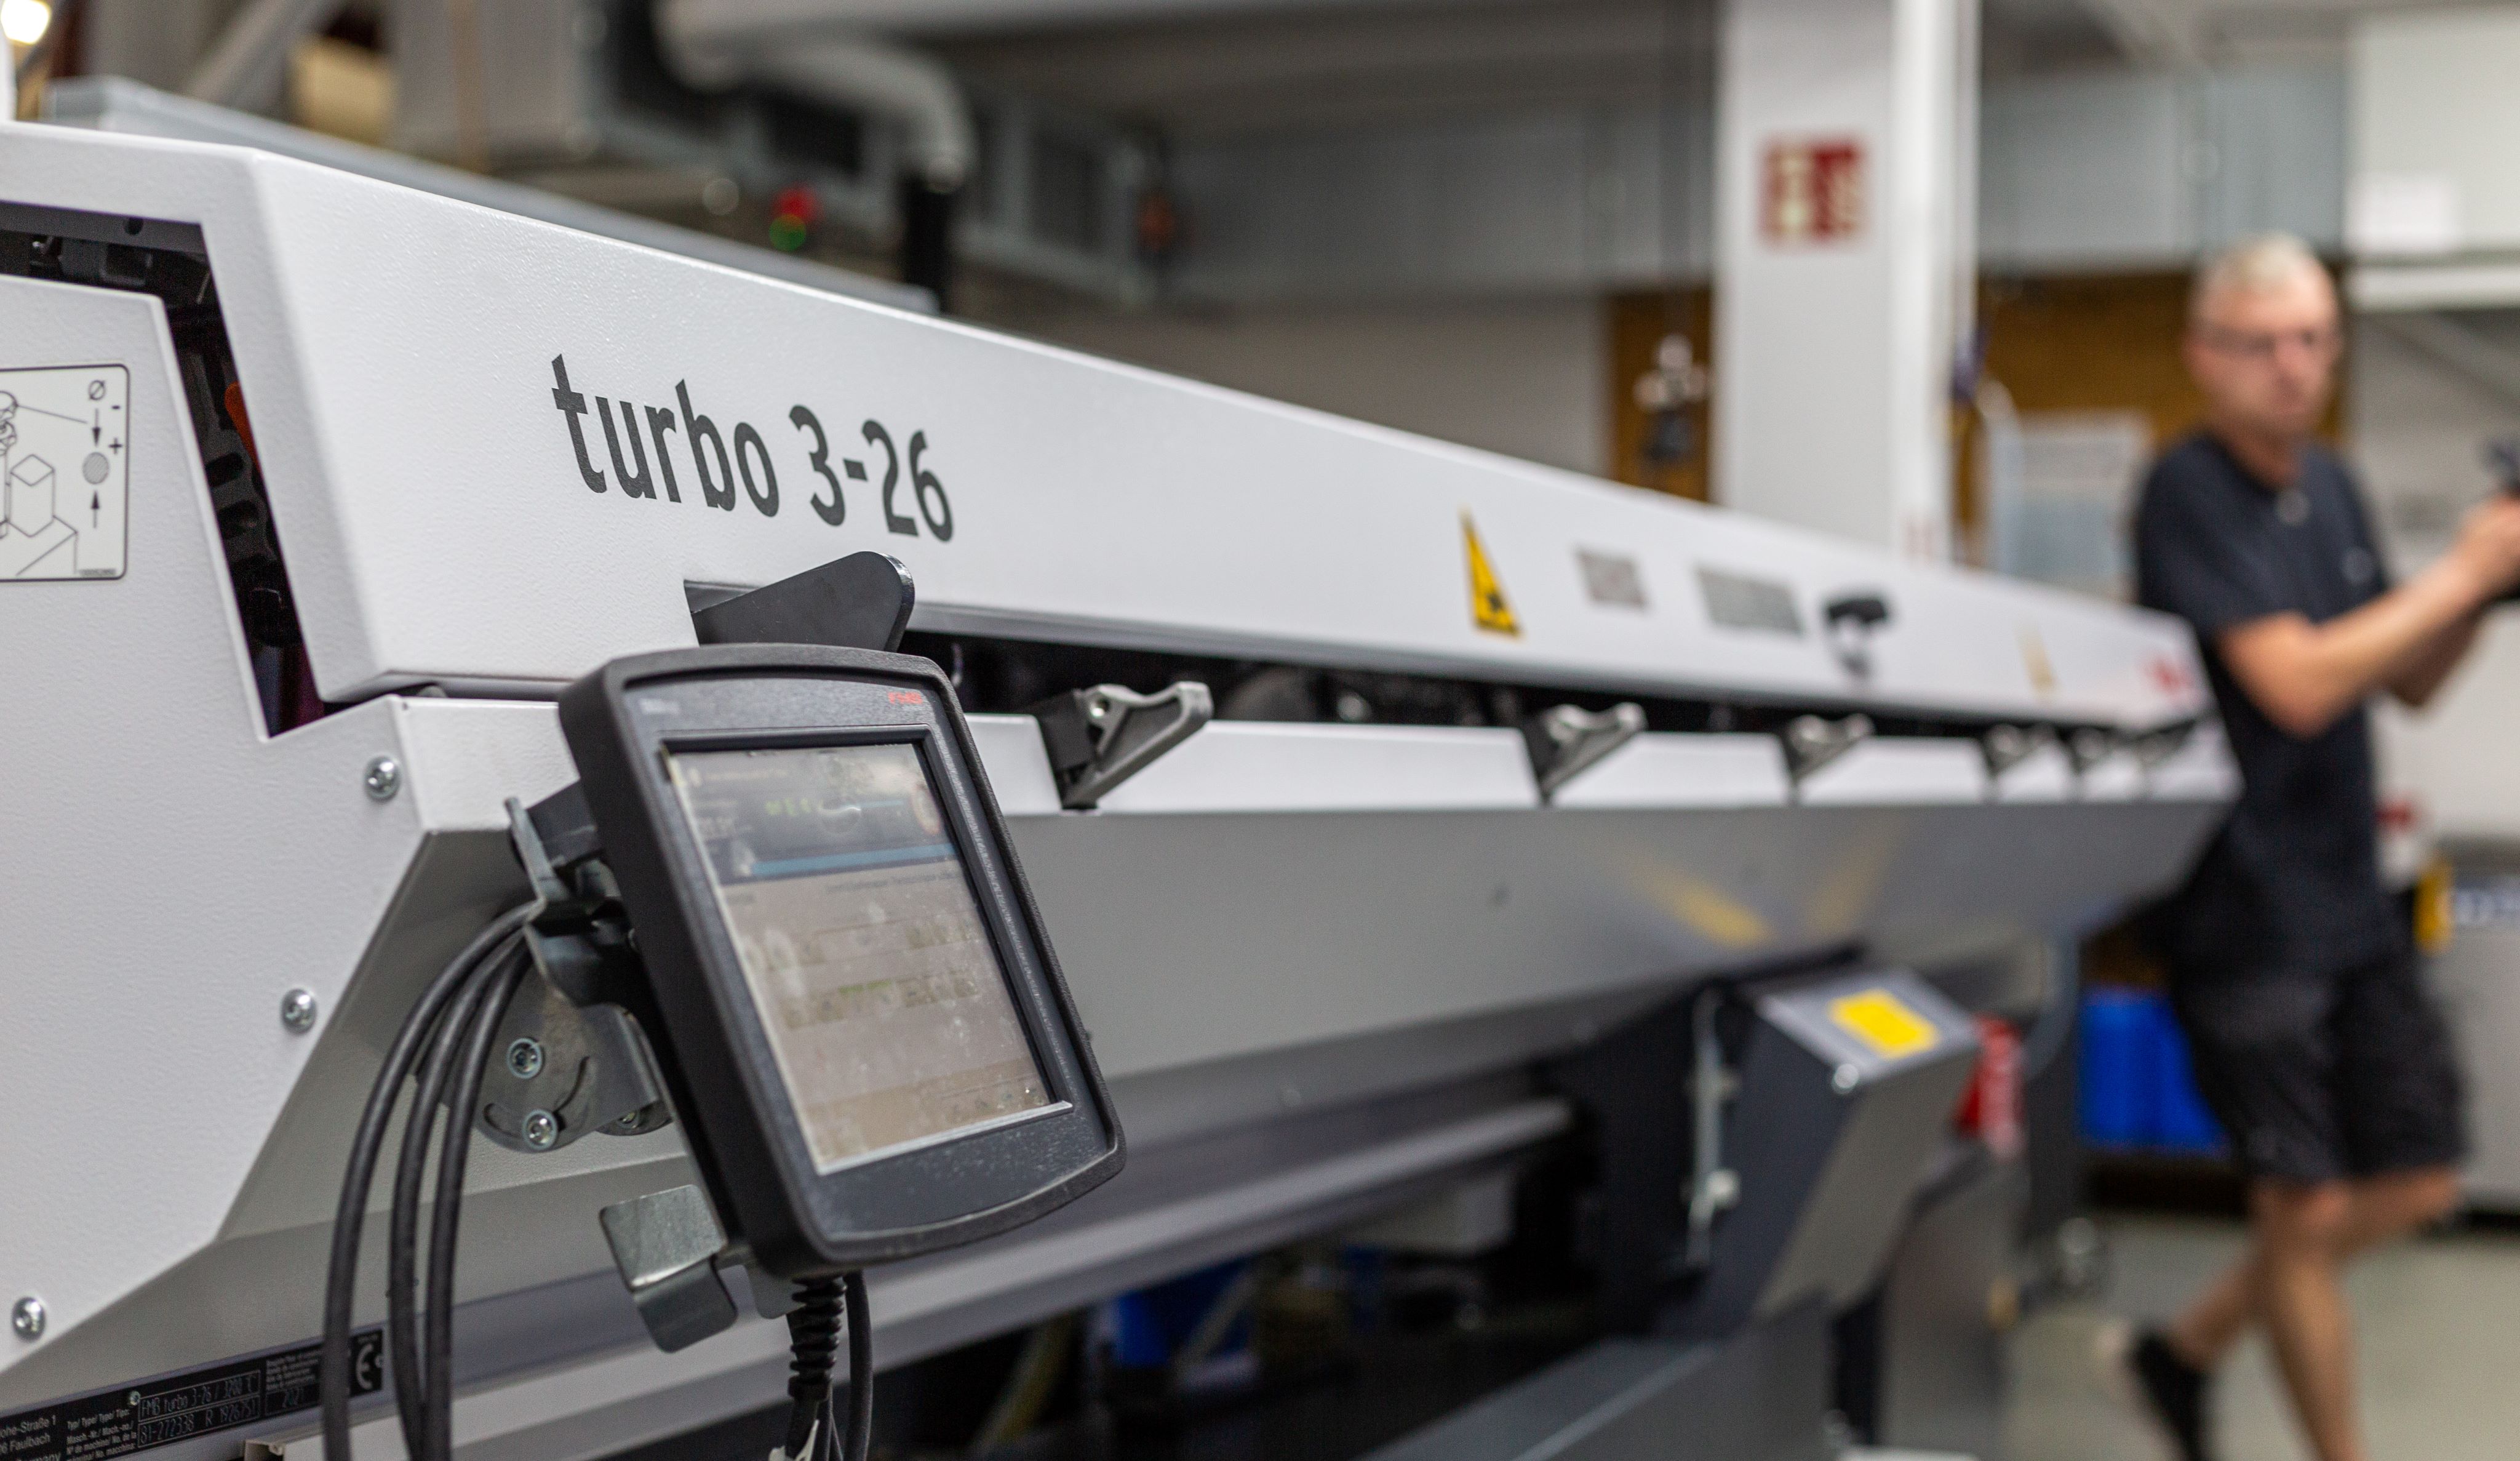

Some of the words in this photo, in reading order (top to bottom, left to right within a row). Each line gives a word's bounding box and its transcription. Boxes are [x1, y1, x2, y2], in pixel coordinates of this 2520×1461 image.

[552, 353, 780, 518] turbo
[789, 405, 954, 543] 3-26
[142, 1397, 161, 1417] FMB
[164, 1393, 188, 1412] turbo
[191, 1386, 212, 1406] 3-26
[51, 1414, 57, 1426] 1
[10, 1433, 50, 1452] Faulbach
